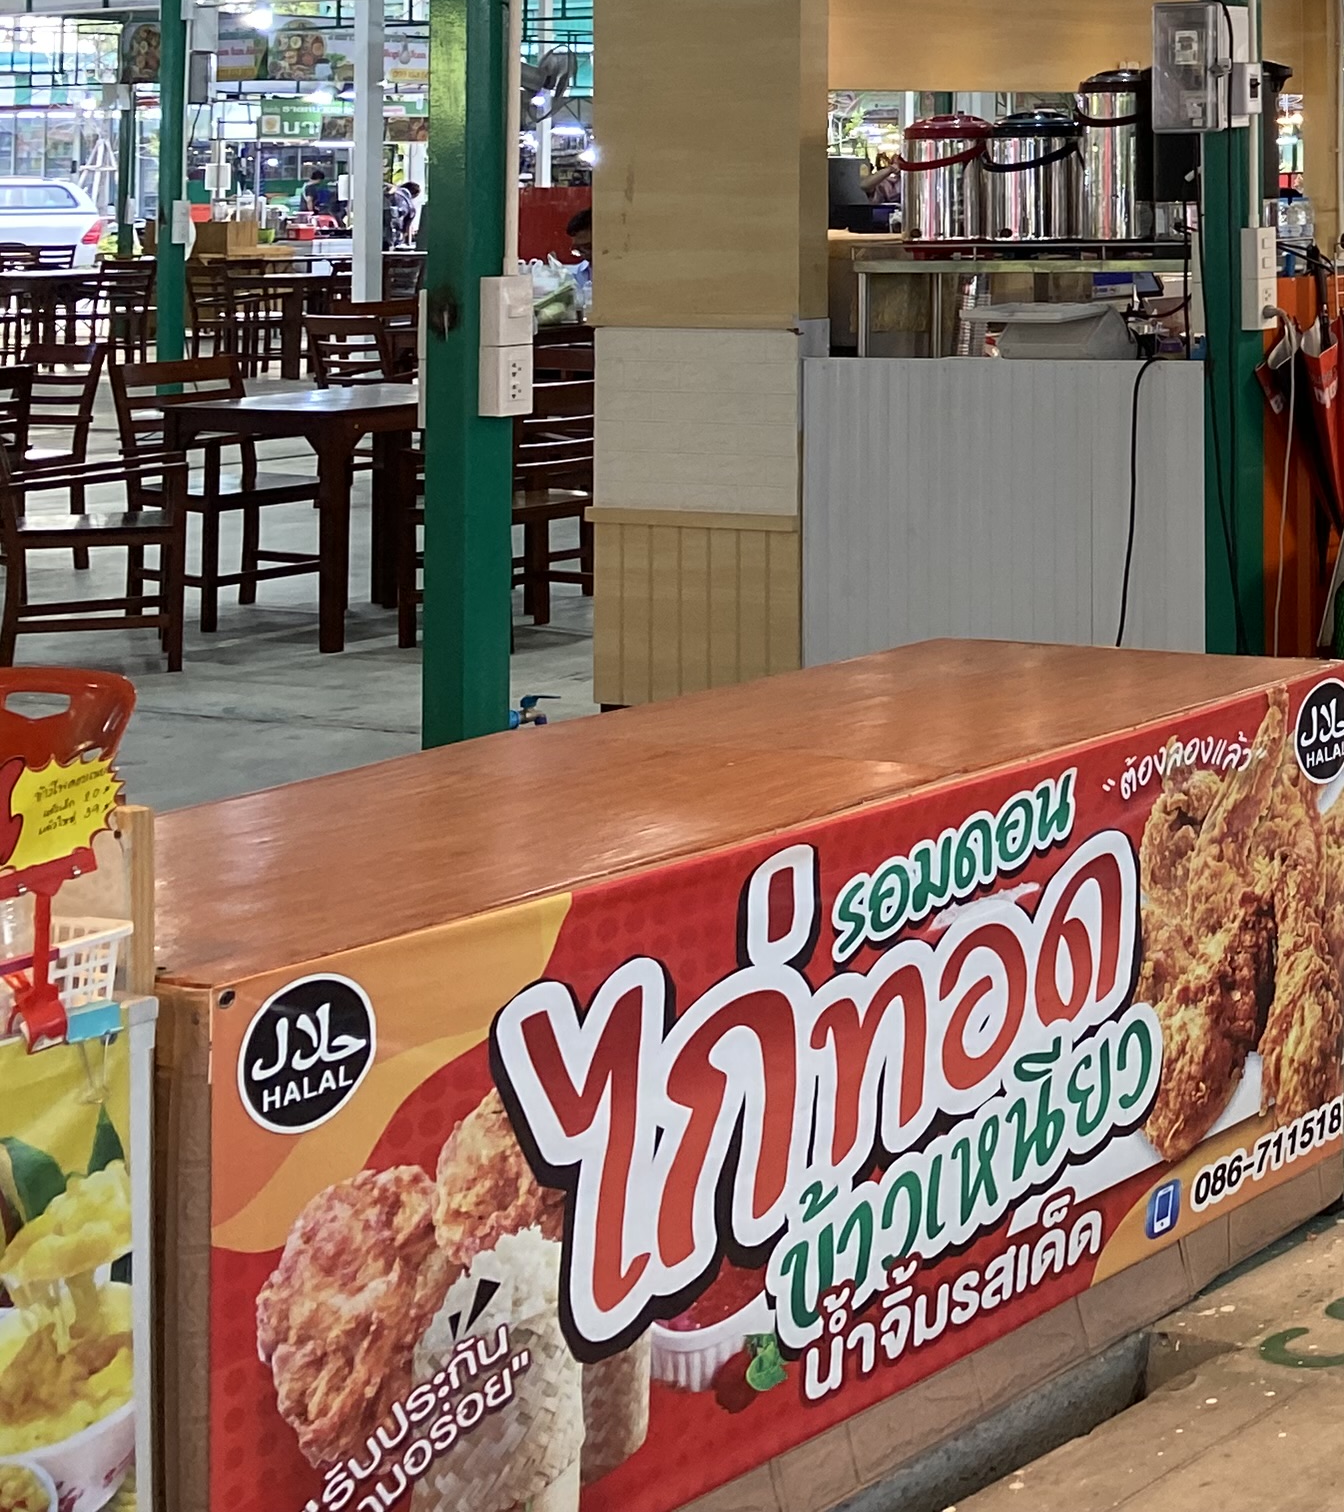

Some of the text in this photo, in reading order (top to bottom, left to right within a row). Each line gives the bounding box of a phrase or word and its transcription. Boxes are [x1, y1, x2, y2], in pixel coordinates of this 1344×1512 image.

[261, 1069, 355, 1115] HALAL
[497, 833, 1137, 1338] ไก่ทอด
[776, 1010, 1157, 1334] ข้าวเหนียว
[801, 1187, 1104, 1400] น้ำจิ้มรสเด็ด
